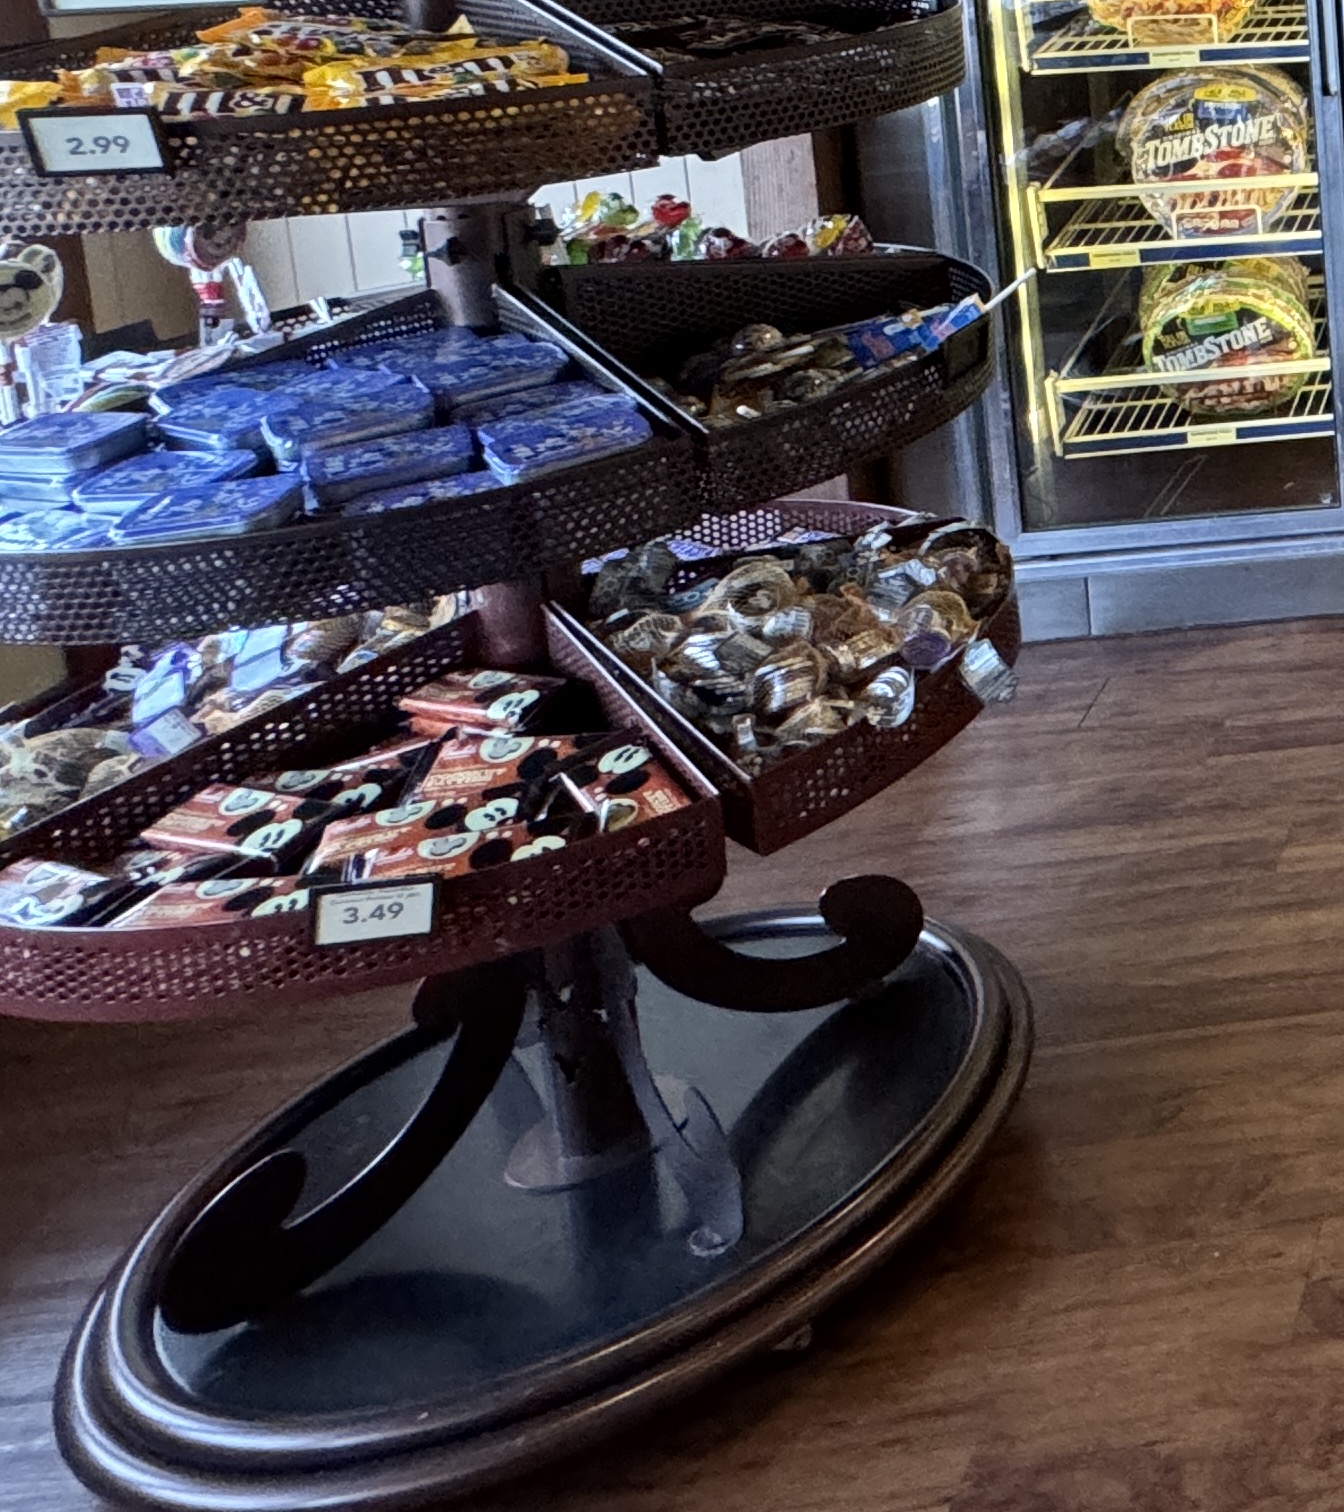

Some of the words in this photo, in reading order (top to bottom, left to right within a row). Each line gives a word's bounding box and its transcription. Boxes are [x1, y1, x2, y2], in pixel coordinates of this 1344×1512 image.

[66, 135, 131, 156] 2.99
[1144, 115, 1278, 169] TOMBSTONE
[342, 902, 404, 924] 3.49
